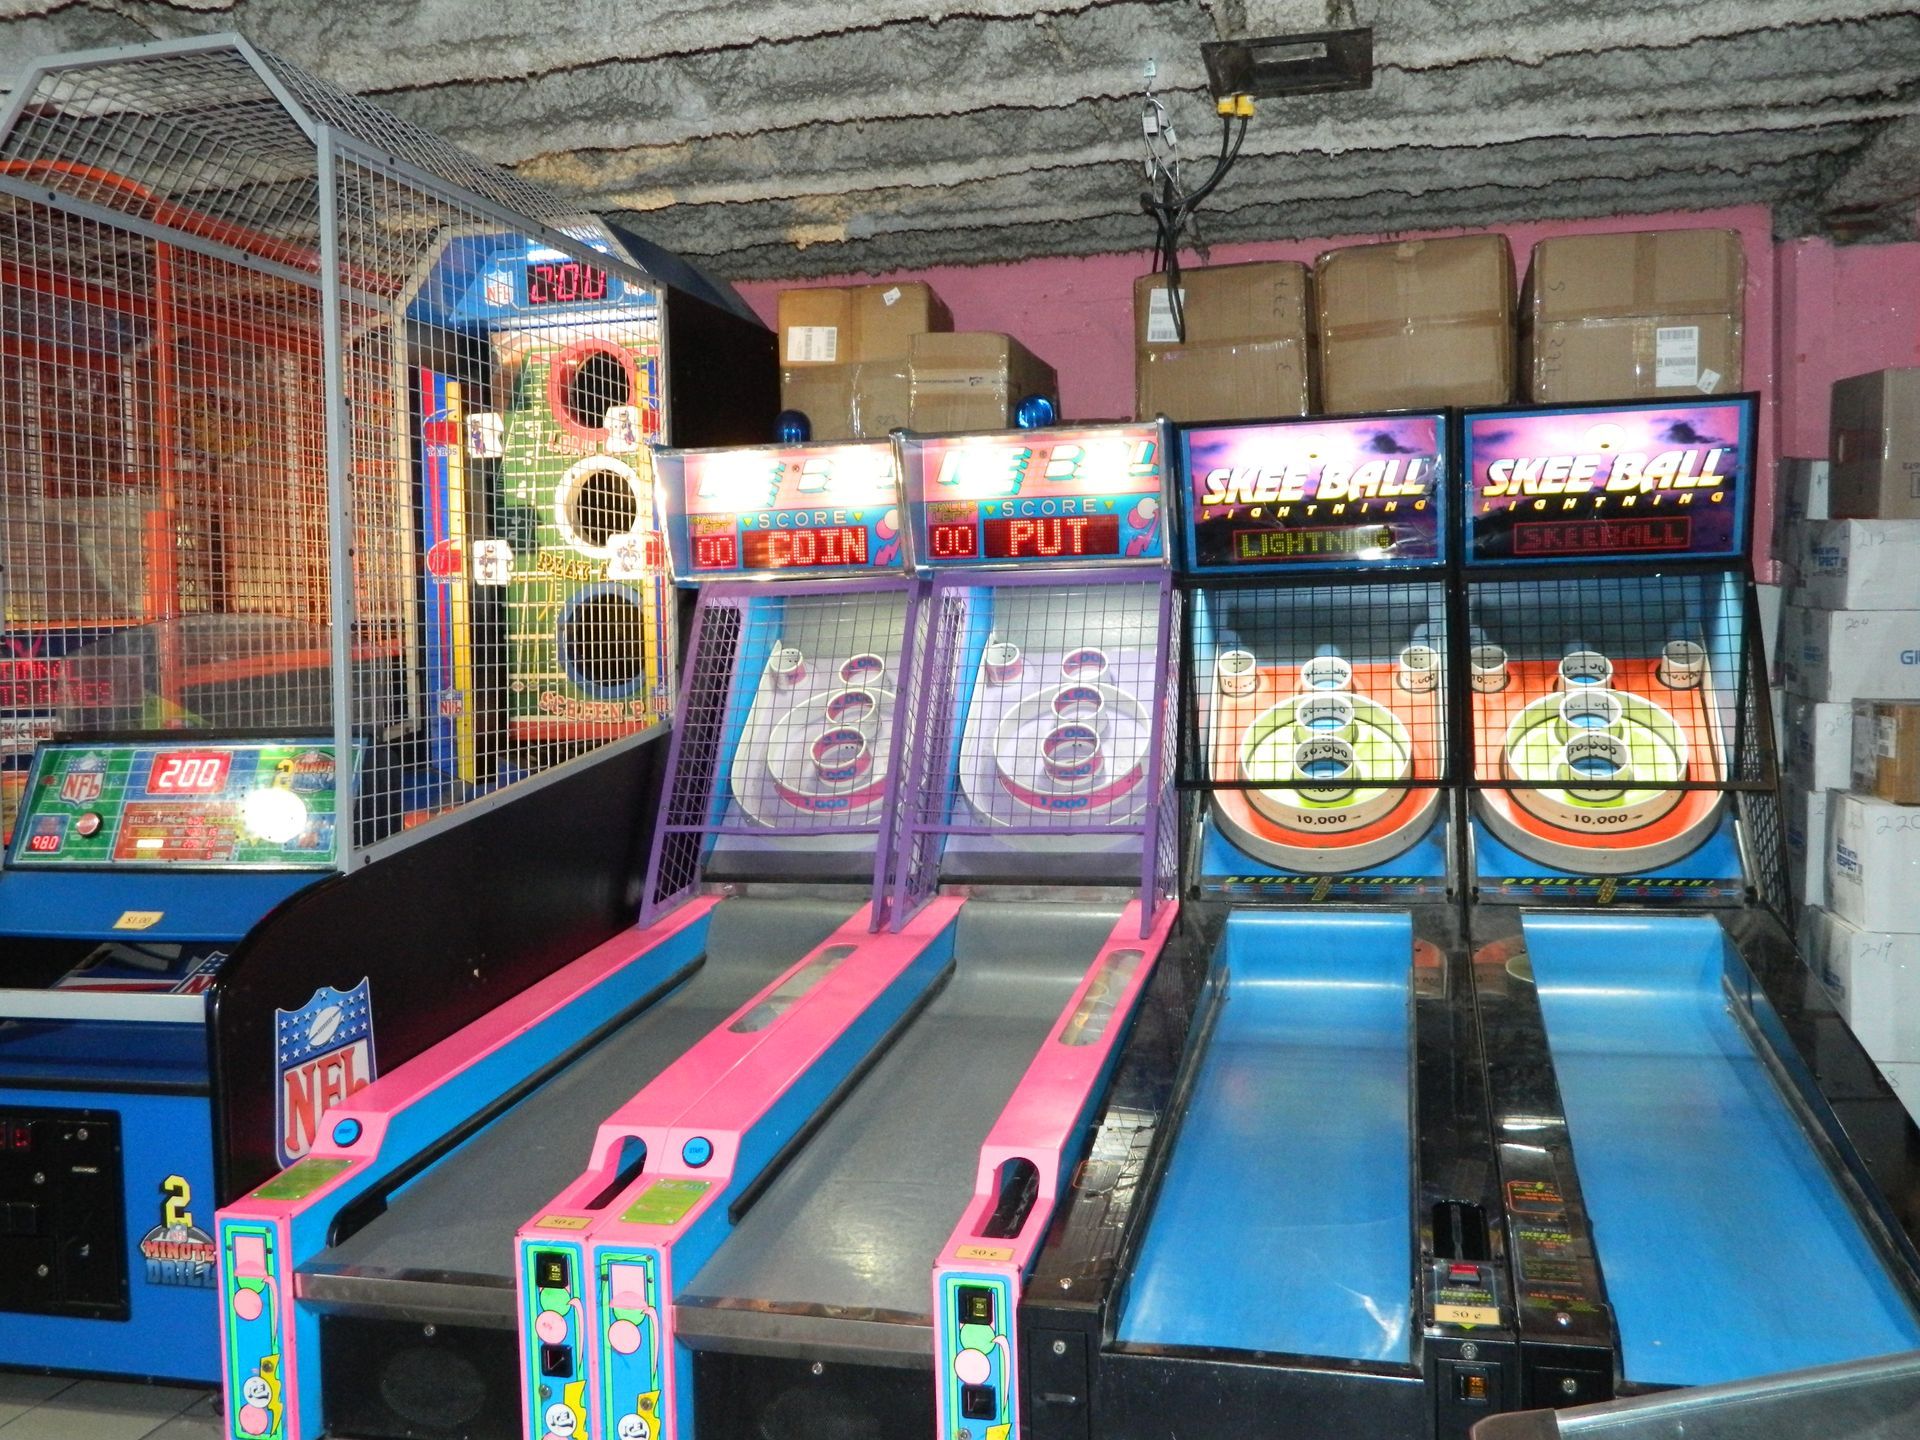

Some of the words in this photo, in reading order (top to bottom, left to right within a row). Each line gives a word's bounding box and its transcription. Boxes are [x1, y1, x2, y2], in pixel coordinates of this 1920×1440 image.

[1203, 464, 1311, 505] SKEE
[1316, 458, 1426, 502] BALL
[1483, 454, 1602, 497] SKEE
[1605, 448, 1724, 495] BALL
[1002, 499, 1097, 517] SCORE
[1203, 500, 1427, 520] LIGHTNING
[1482, 491, 1724, 512] LIGHTNING
[758, 510, 847, 529] SCORE
[768, 527, 866, 565] COIN
[935, 526, 973, 555] 00
[1010, 518, 1088, 555] PUT
[1241, 529, 1390, 558] LIGHTNING
[1522, 522, 1685, 549] SKEEBALL
[698, 537, 733, 565] 00
[62, 773, 101, 798] NFL
[158, 759, 221, 788] 200
[1225, 876, 1319, 884] DOUBLE
[1502, 877, 1602, 886] DOUBLE
[285, 1046, 367, 1152] NFL
[163, 1174, 193, 1228] 2
[144, 1240, 216, 1263] MINUTE
[1452, 1310, 1469, 1318] 50
